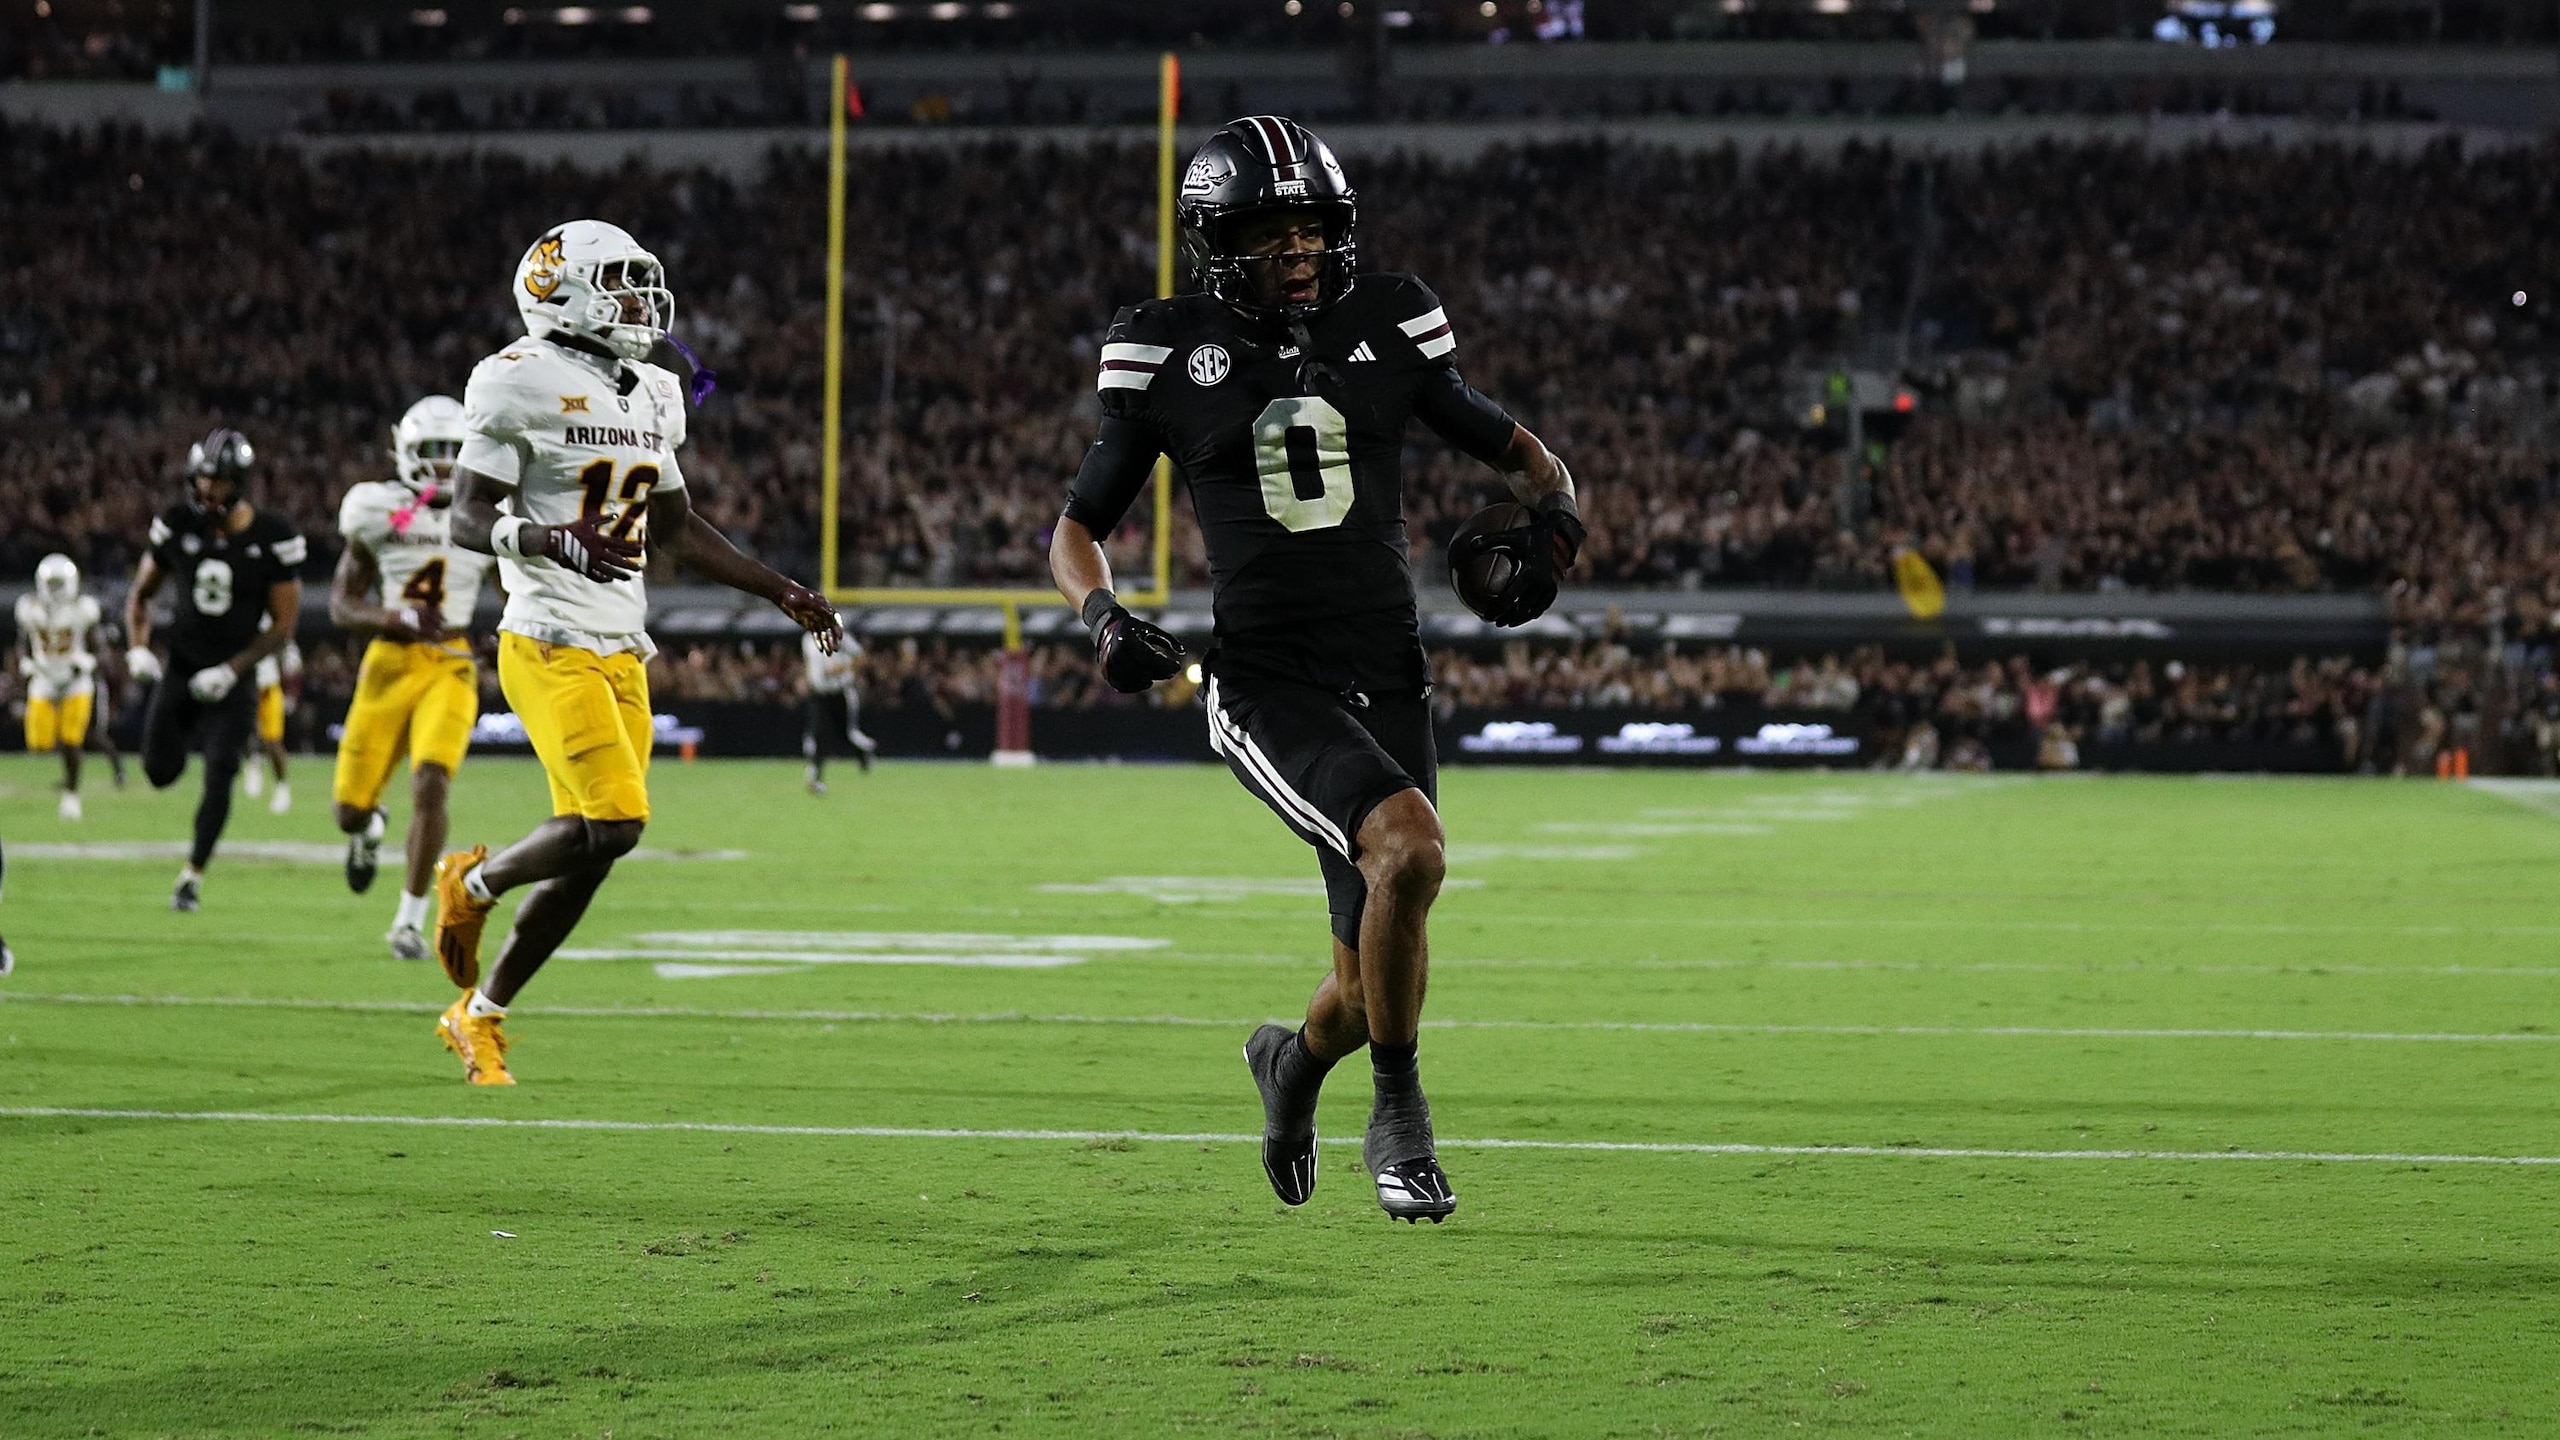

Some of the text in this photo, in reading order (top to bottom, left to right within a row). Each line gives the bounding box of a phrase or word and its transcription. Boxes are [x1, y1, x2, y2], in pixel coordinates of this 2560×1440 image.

[1275, 185, 1307, 196] STATE
[1191, 346, 1227, 384] SEC
[565, 426, 639, 447] ARIZONA
[1252, 396, 1355, 533] 0
[579, 457, 661, 560] 12
[193, 557, 233, 617] 8
[402, 555, 448, 608] 4
